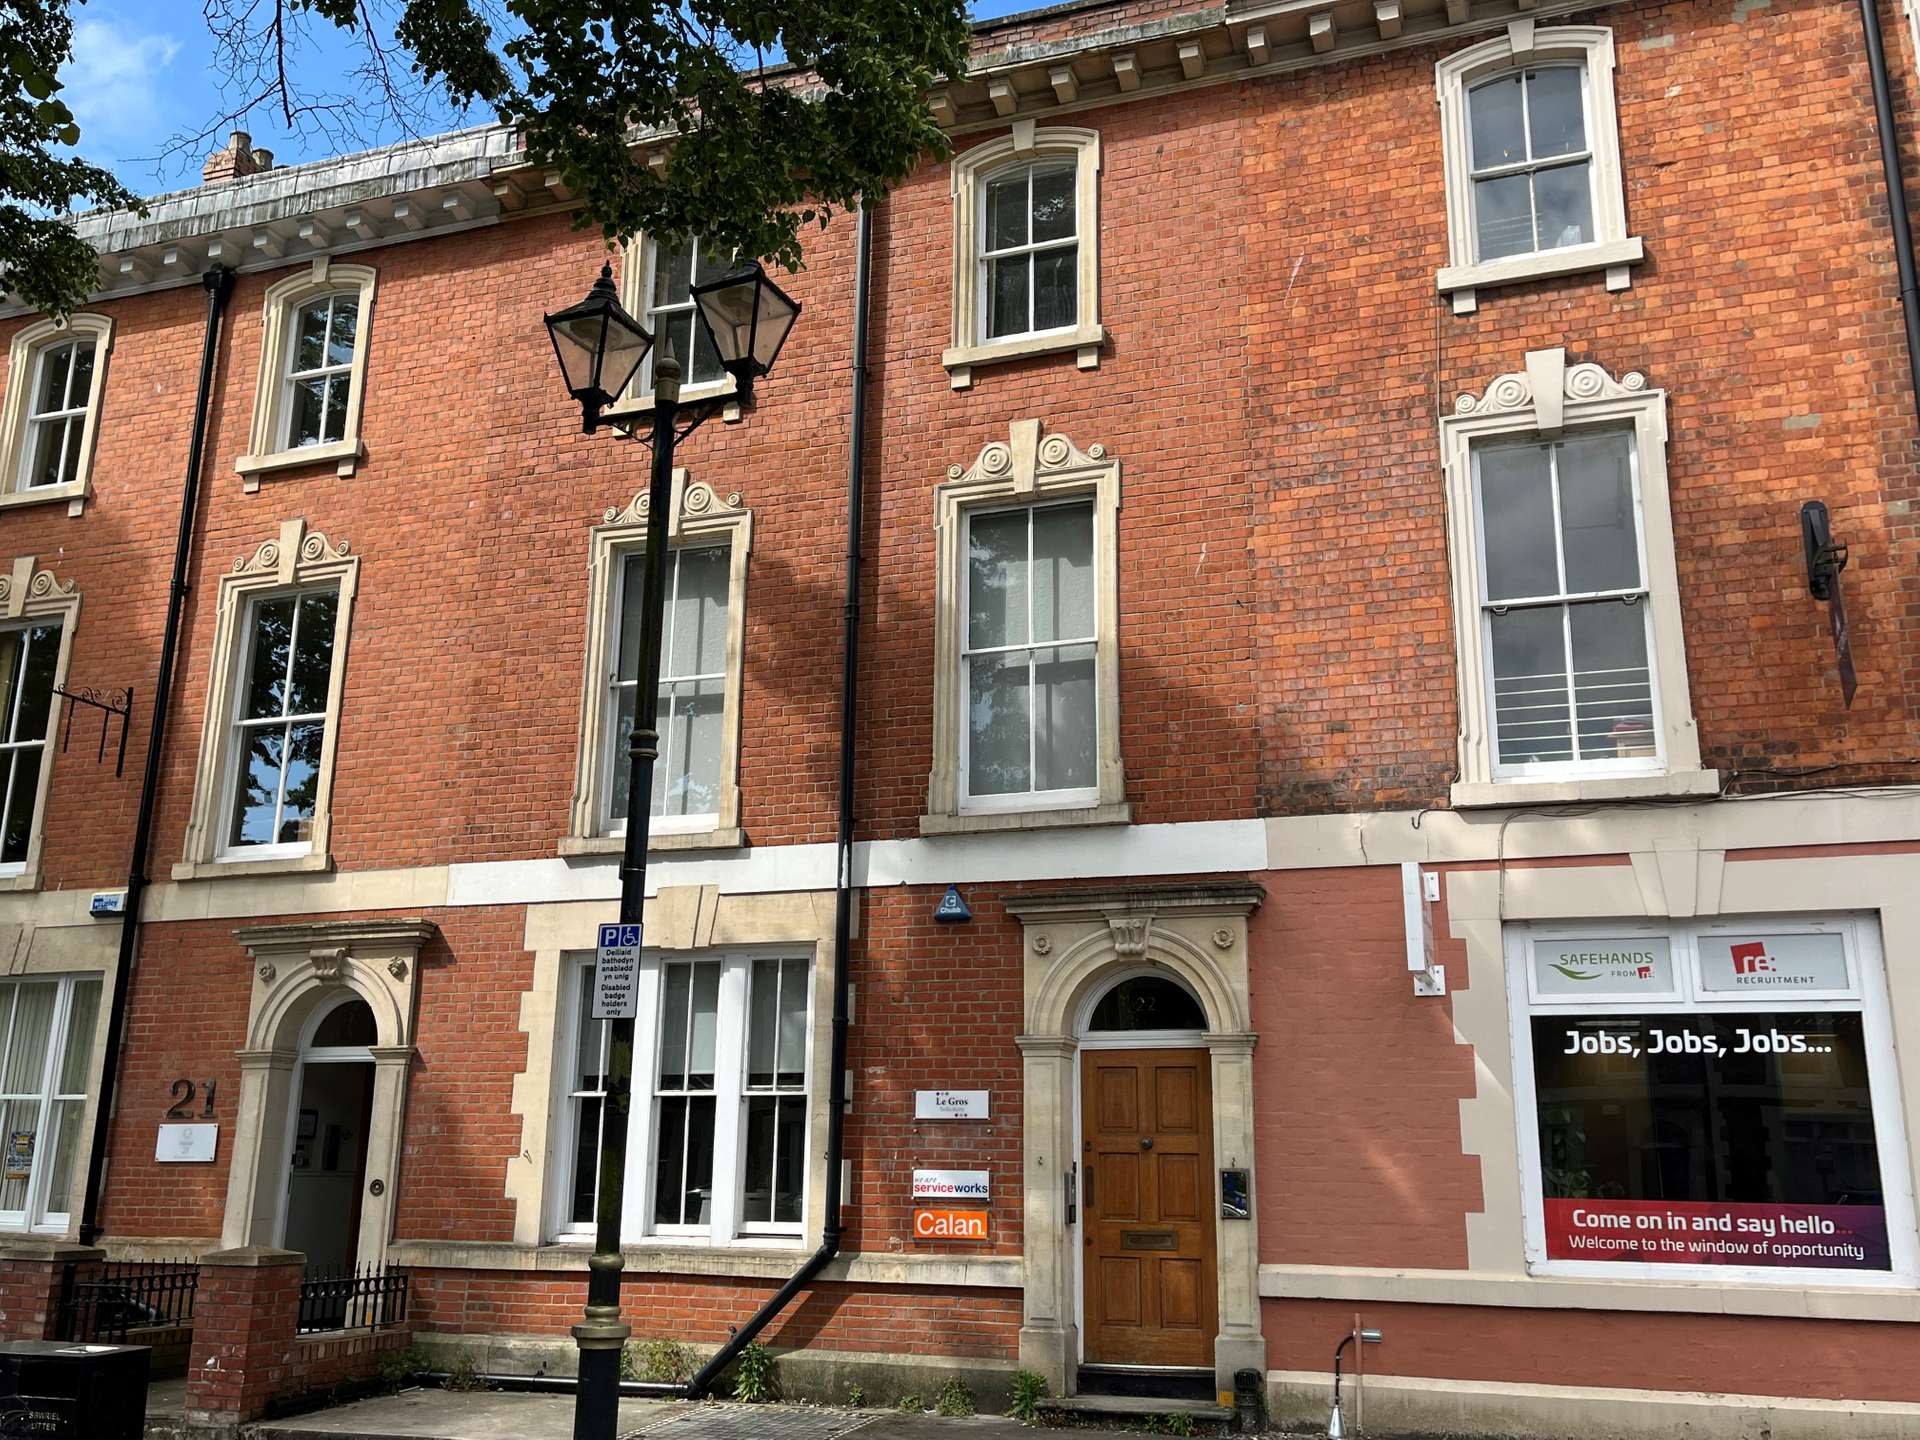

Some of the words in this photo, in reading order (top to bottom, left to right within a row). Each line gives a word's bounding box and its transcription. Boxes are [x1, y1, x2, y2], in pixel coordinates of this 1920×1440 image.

[604, 928, 617, 946] P
[601, 957, 634, 965] bathodyn
[1559, 951, 1654, 966] SAFEHANDS
[614, 972, 629, 981] unig
[1736, 976, 1816, 985] RECRUITMENT
[604, 991, 625, 1000] badge
[601, 1000, 628, 1008] holders
[1563, 1030, 1641, 1058] Jobs,
[1647, 1029, 1727, 1058] Jobs,
[1733, 1028, 1832, 1054] Jobs...
[166, 1079, 218, 1120] 21
[935, 1097, 947, 1106] Le
[948, 1096, 969, 1106] Gros
[914, 1182, 988, 1194] serviceworks
[916, 1212, 986, 1237] Calan.
[1572, 1208, 1631, 1229] Come
[1636, 1215, 1663, 1230] on
[1667, 1211, 1688, 1231] in
[1691, 1213, 1732, 1232] and
[1736, 1217, 1777, 1238] say
[1568, 1234, 1639, 1251] Welcome
[1641, 1238, 1657, 1251] to
[1660, 1237, 1686, 1252] the
[1688, 1239, 1749, 1254] window
[1752, 1240, 1769, 1255] of
[1772, 1242, 1865, 1261] opportunity
[31, 1422, 57, 1431] LITTER
